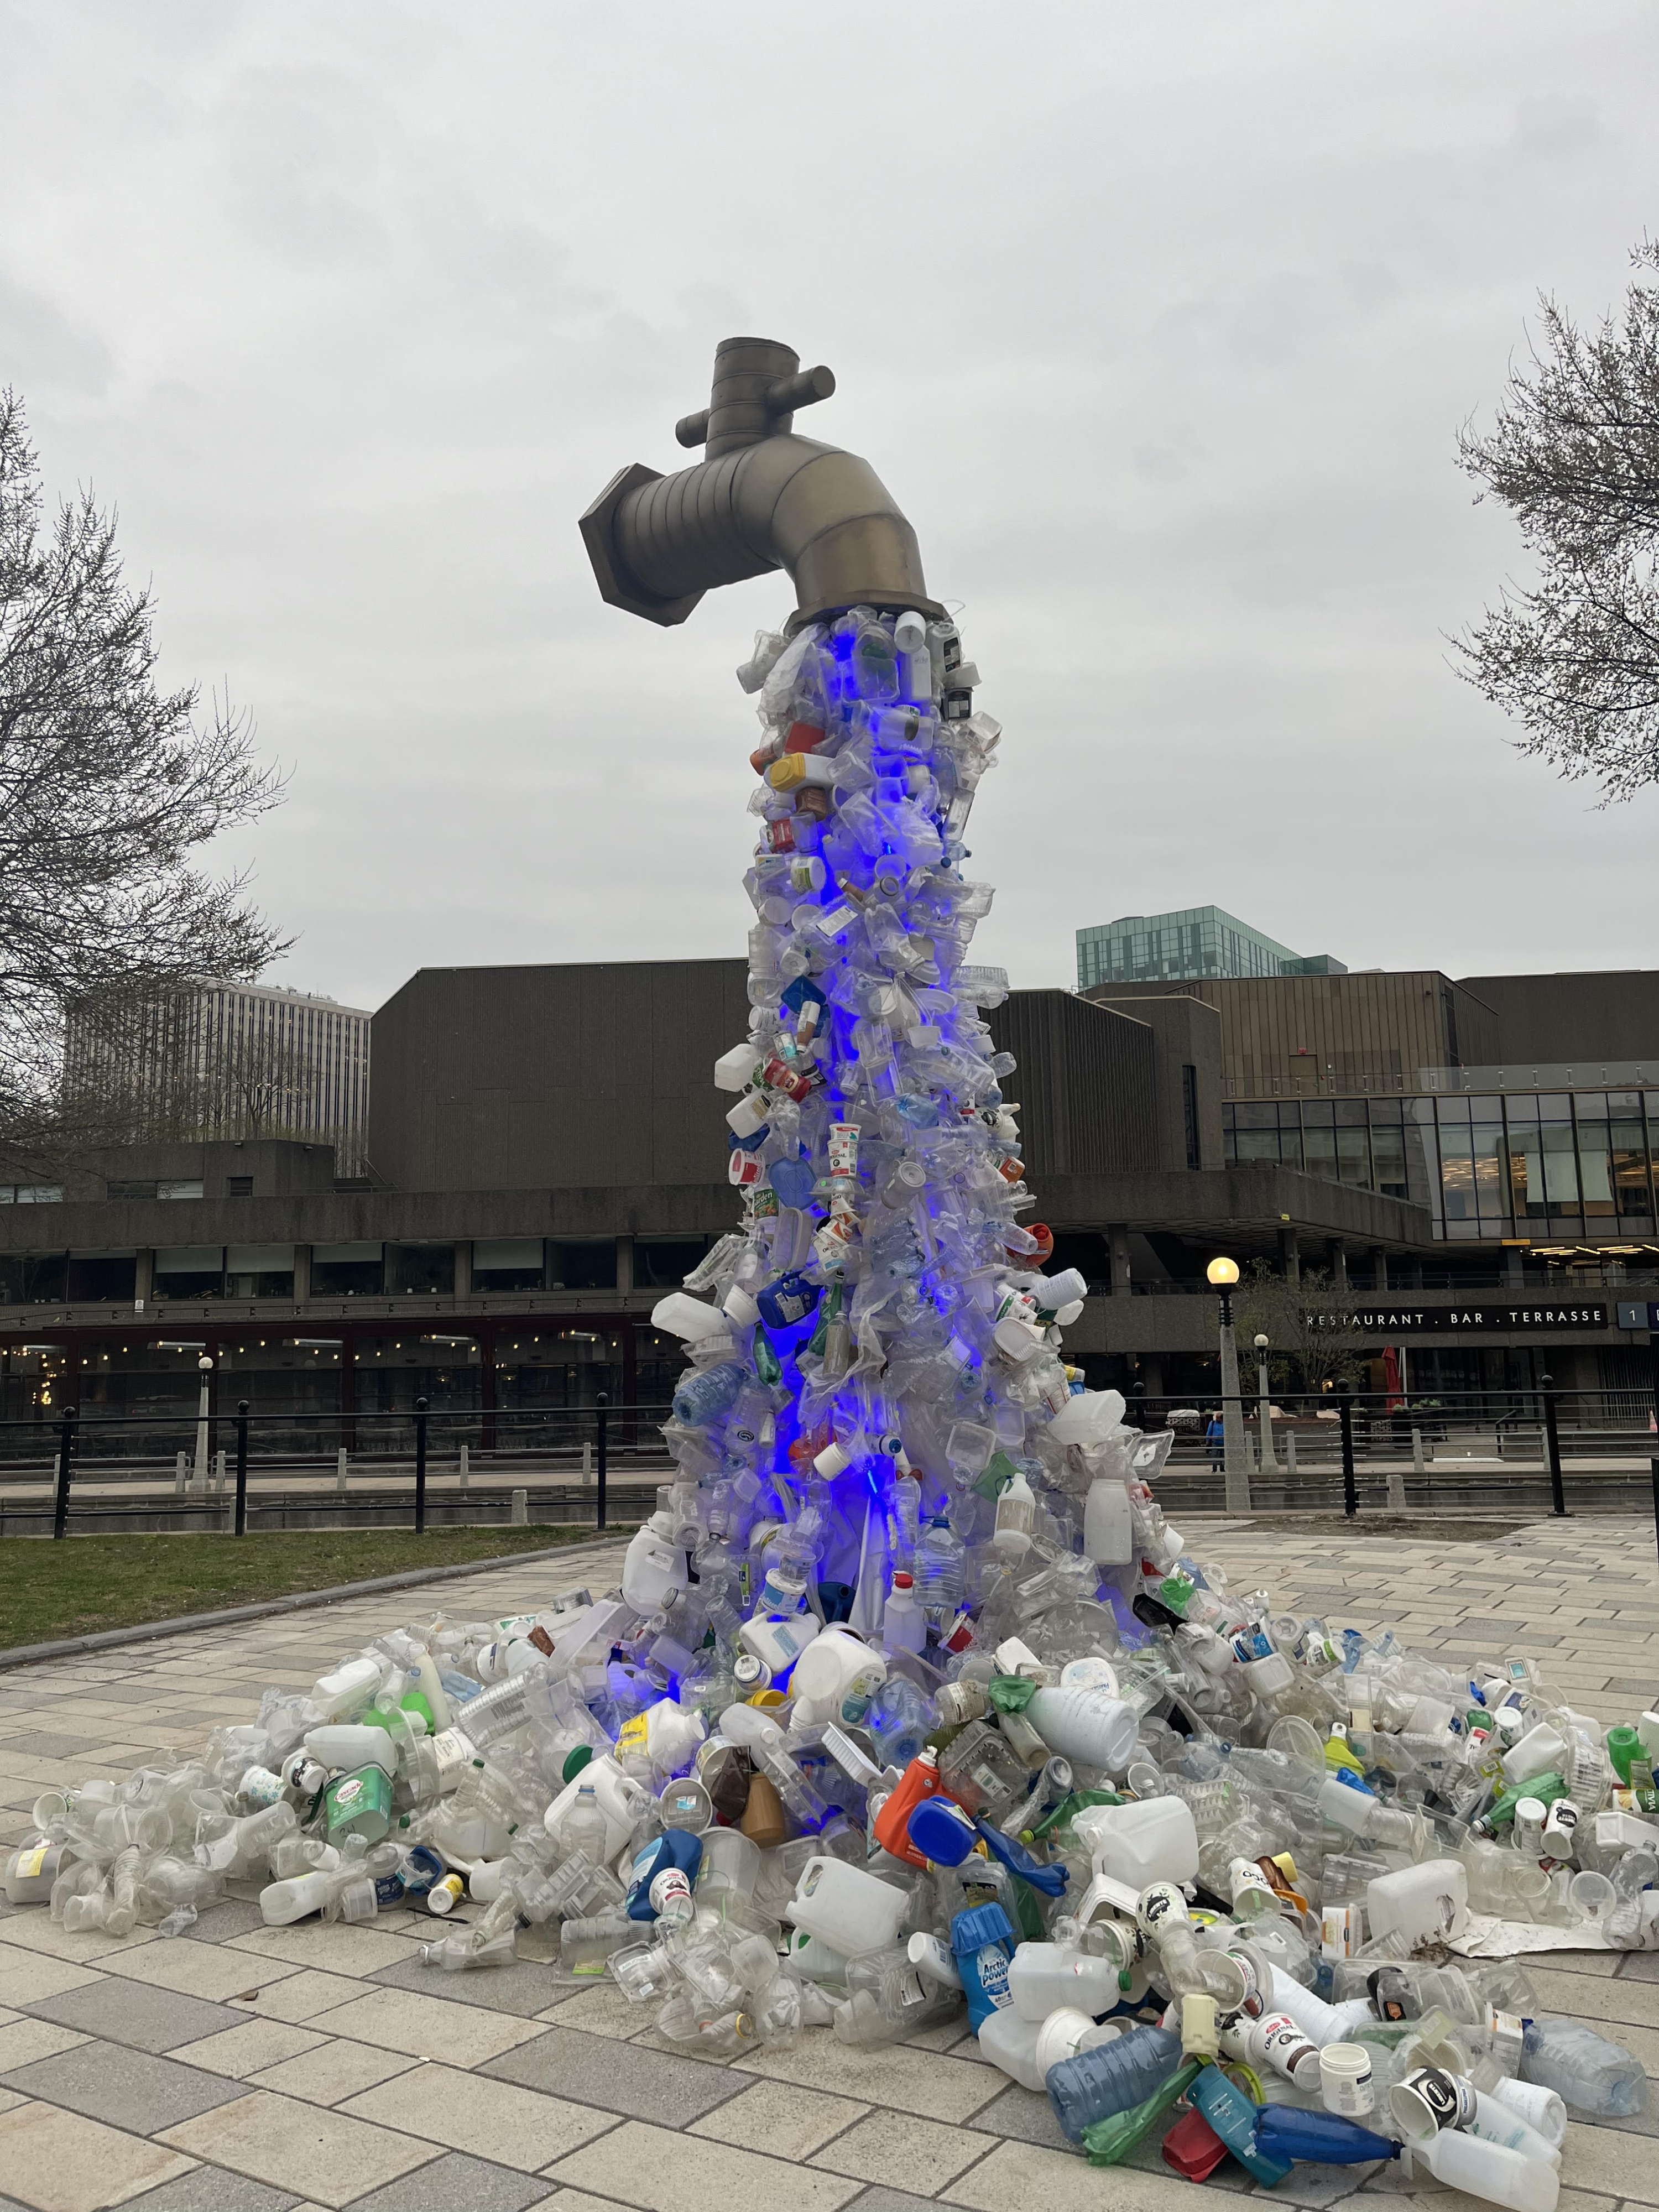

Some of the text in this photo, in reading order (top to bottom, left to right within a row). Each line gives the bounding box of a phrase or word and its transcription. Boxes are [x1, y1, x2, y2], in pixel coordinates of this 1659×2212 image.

[754, 1191, 773, 1206] arden
[1307, 1314, 1423, 1326] RESTAURANT
[1451, 1313, 1483, 1323] BAR
[1509, 1311, 1601, 1323] TERRASSE
[1629, 1310, 1635, 1321] 1
[333, 1781, 364, 1801] Cascade
[1647, 1790, 1656, 1811] TIVIA
[984, 1958, 1006, 1974] Arctic
[1264, 2025, 1295, 2050] ORIGINAL
